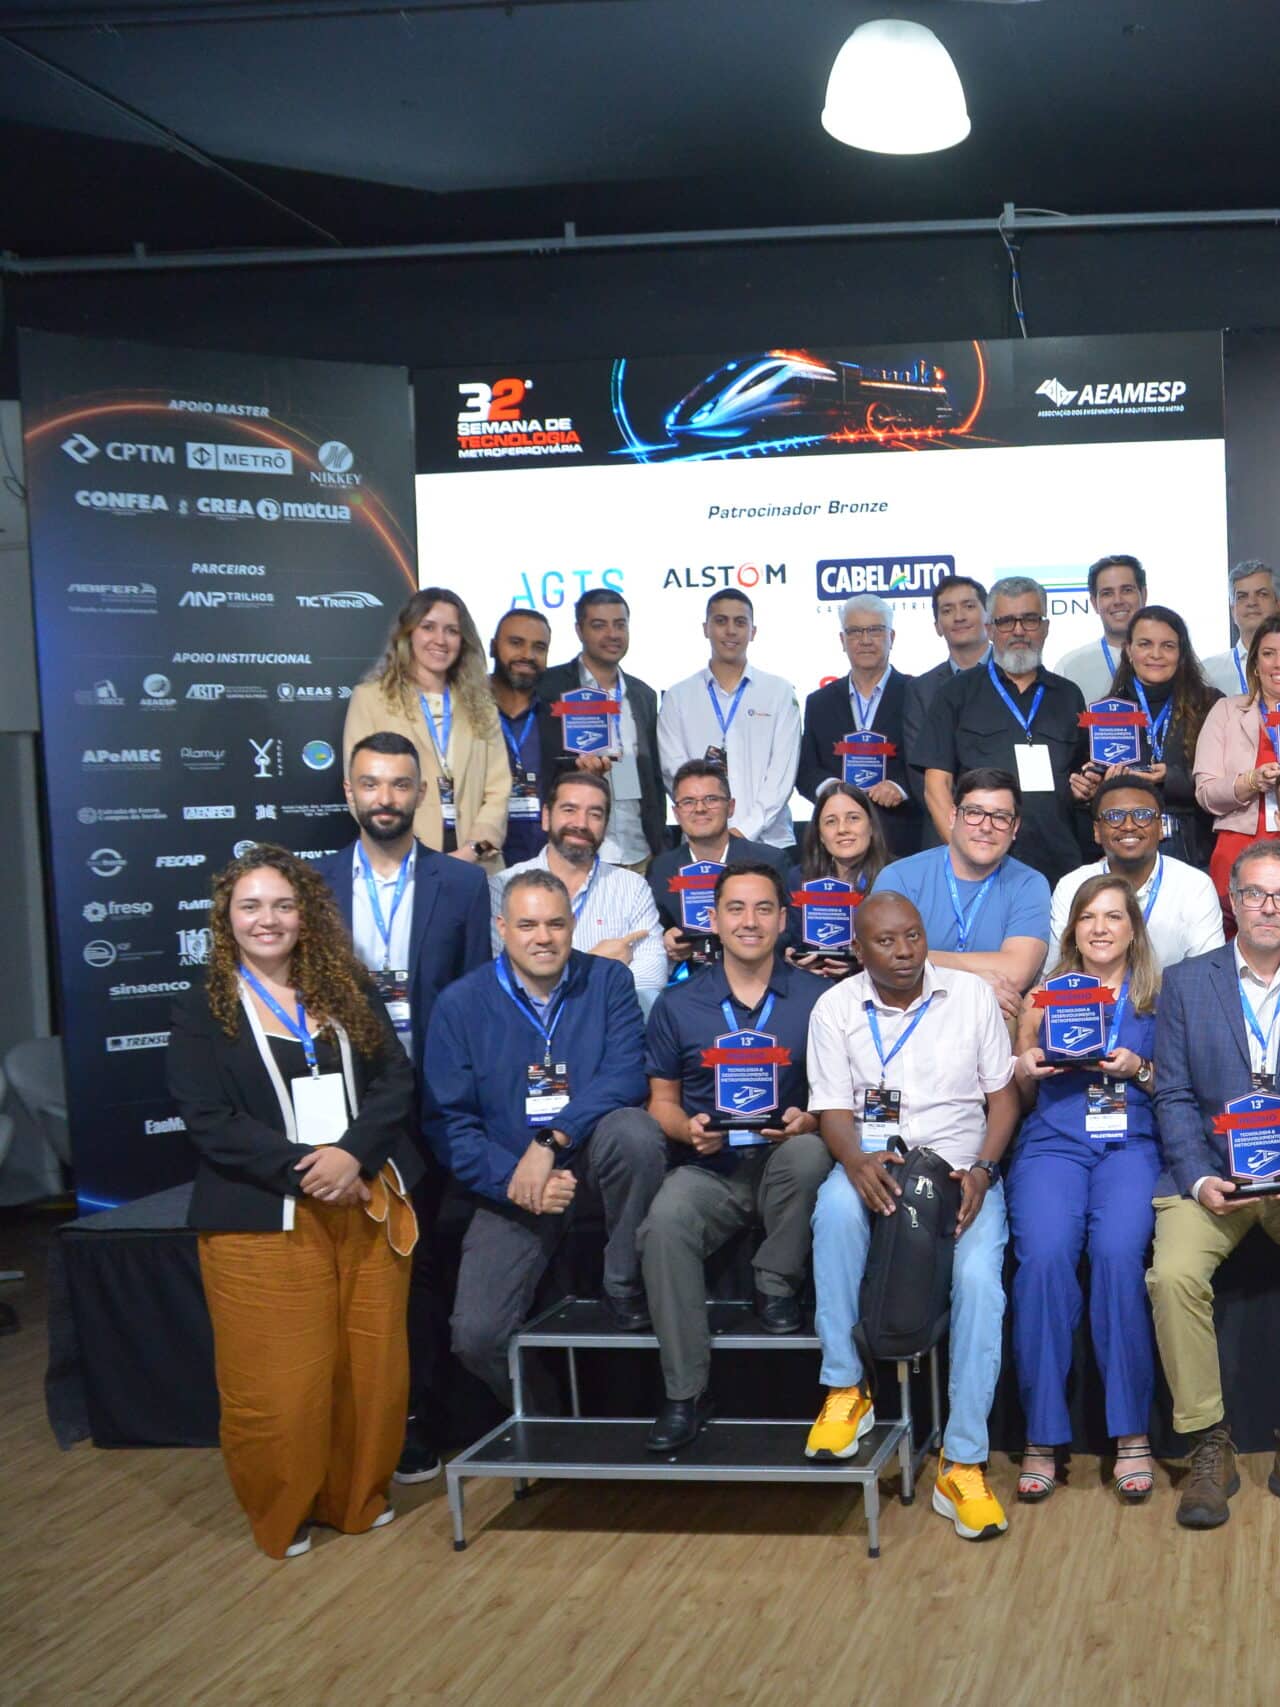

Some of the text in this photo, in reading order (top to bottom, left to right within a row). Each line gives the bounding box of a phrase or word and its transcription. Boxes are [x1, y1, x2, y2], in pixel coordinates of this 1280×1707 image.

[1077, 381, 1187, 405] AEAMESP
[168, 399, 270, 417] APOIO MASTER
[457, 417, 572, 436] SEMANA DE
[457, 430, 582, 449] TECNOLOGIA
[105, 441, 176, 464] CPTM
[458, 443, 584, 458] METROFERROVIÁRIA
[223, 452, 286, 469] METRÔ
[310, 471, 362, 485] NIKKEY
[75, 490, 169, 511] CONFEA
[196, 497, 255, 514] CREA
[708, 500, 889, 519] Patrocinador Bronze
[191, 563, 266, 576] PARCEIROS
[663, 562, 787, 589] ALSTOM
[821, 562, 951, 593] CABELAUTO
[172, 653, 312, 665] APOIO INSTITUCIONAL
[296, 686, 333, 696] AEAS
[82, 749, 162, 763] APeMEC
[155, 854, 208, 867] FECAP
[108, 901, 154, 915] fresp
[109, 981, 191, 996] sinaenco
